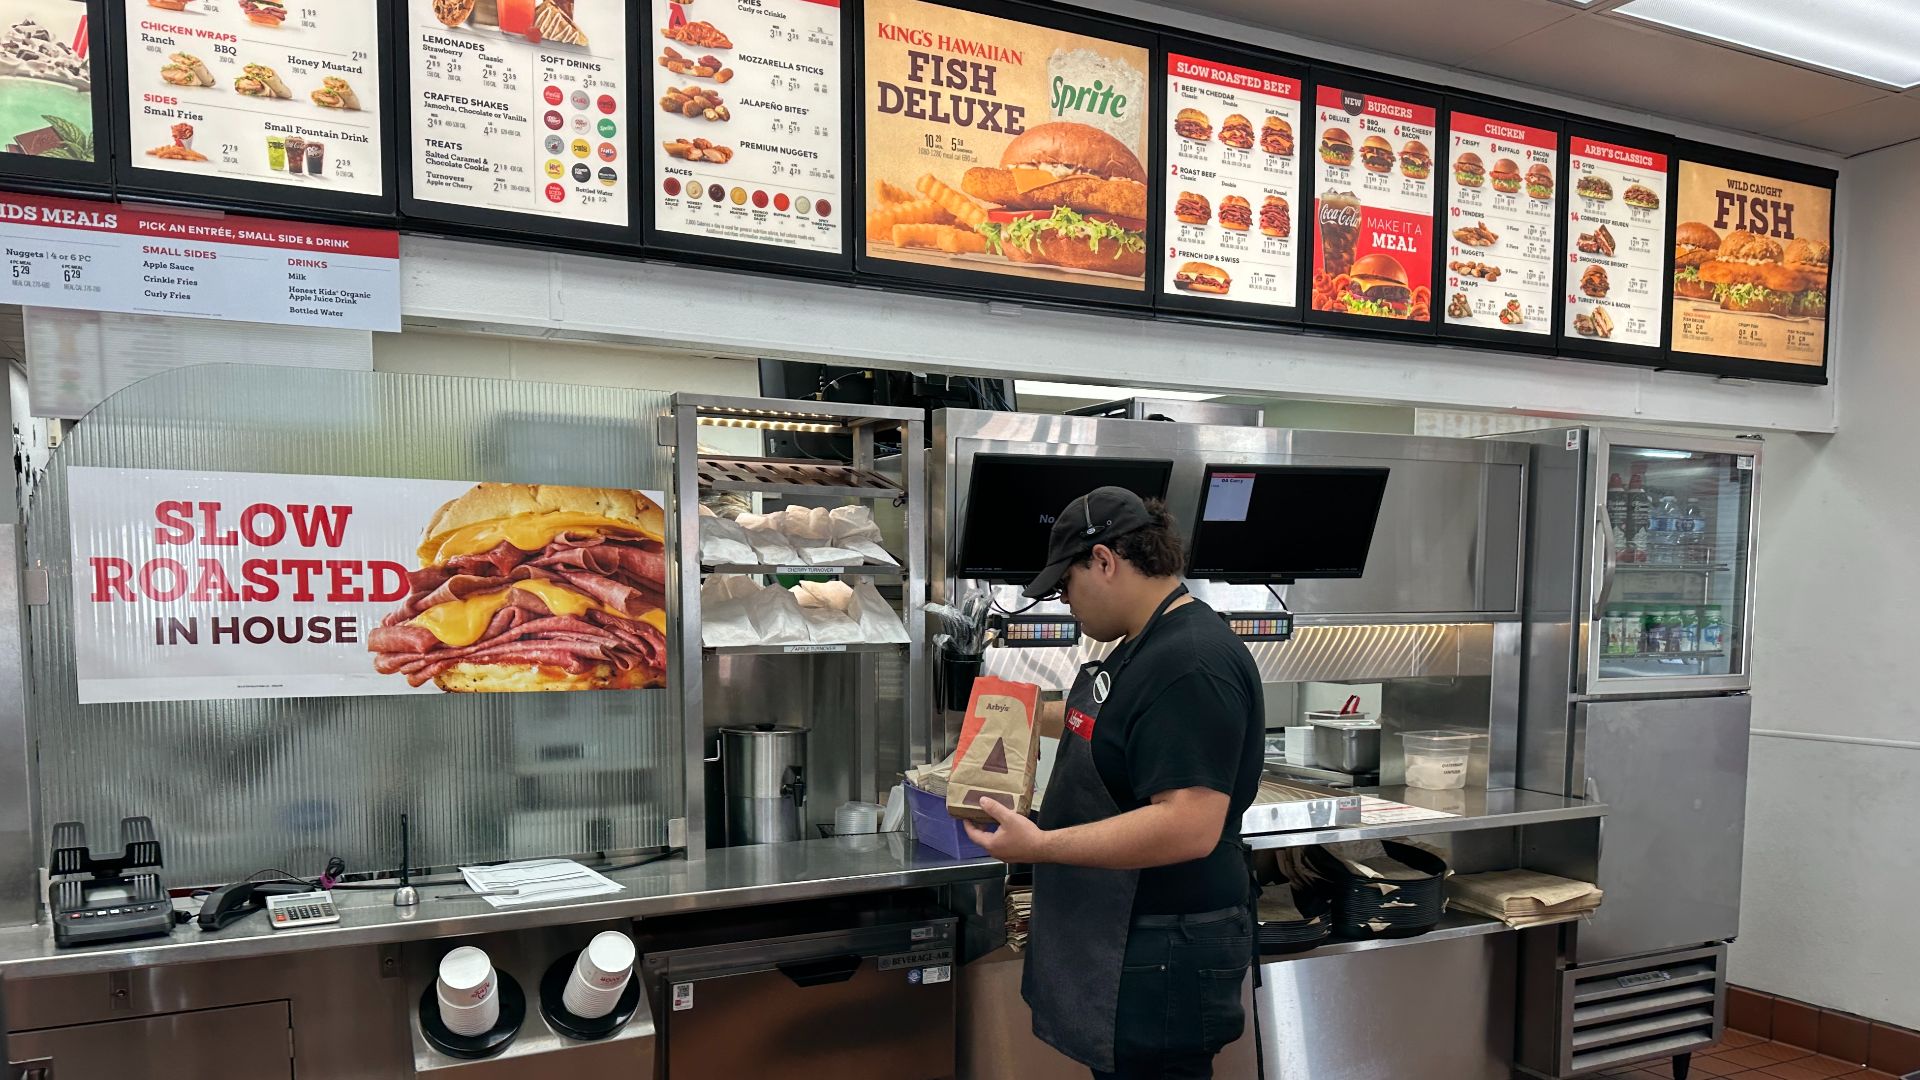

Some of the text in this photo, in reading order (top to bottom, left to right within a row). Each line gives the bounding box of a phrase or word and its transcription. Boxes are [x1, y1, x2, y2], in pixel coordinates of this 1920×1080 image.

[738, 5, 755, 14] Curly
[764, 10, 786, 19] Crinkle
[141, 21, 237, 43] CHICKEN WRAPS
[142, 33, 175, 46] Ranch
[422, 34, 485, 51] LEMONADES
[878, 23, 1023, 65] KING'S HAWAIIAN
[214, 44, 236, 56] BBQ
[423, 44, 463, 57] Strawberry
[288, 56, 362, 74] Honey Mustard
[479, 54, 503, 63] Classic
[541, 55, 601, 71] SOFT DRINKS
[739, 54, 824, 75] MOZZARELLA STICKS
[908, 50, 997, 96] FISH
[1177, 62, 1291, 95] SLOW ROASTED BEEF
[1051, 75, 1127, 117] Sprite
[1173, 82, 1178, 92] 1
[1182, 85, 1197, 93] BEEF
[1205, 90, 1235, 100] CHEDDAR
[144, 93, 177, 105] SIDES
[424, 91, 509, 110] CRAFTED SHAKES
[740, 98, 783, 111] JALAPEÑO
[144, 106, 203, 121] Small Fries
[424, 101, 457, 112] Jamocha,
[459, 106, 492, 117] Chocolate
[503, 113, 526, 122] Vanilla
[878, 81, 1025, 136] DELUXE
[1344, 96, 1413, 119] NEW BURGERS
[1329, 114, 1350, 124] DELUXE
[265, 122, 368, 143] Small Fountain Drink
[1367, 125, 1386, 134] BACON
[1402, 132, 1420, 140] BACON
[1411, 127, 1432, 136] CHEESY
[1485, 124, 1525, 140] CHICKEN
[425, 139, 462, 150] TREATS
[1462, 139, 1480, 147] CRISPY
[740, 141, 818, 159] PREMIUM NUGGETS
[1498, 146, 1520, 155] BUFFALO
[1533, 150, 1549, 158] BACON
[1585, 145, 1652, 166] ARBY'S CLASSICS
[426, 151, 449, 160] Salted
[451, 154, 481, 163] Caramel
[425, 158, 489, 172] Chocolate Cookie
[665, 167, 692, 176] SAUCES
[1171, 165, 1216, 178] 2 ROAST BEEF
[426, 171, 464, 182] Turnovers
[452, 181, 472, 190] Cherry
[576, 186, 595, 194] Bottled
[1727, 179, 1783, 198] WILD CAUGHT
[42, 208, 117, 228] MEALS
[1451, 207, 1484, 218] 10 TENDERS
[1571, 212, 1579, 221] 14
[1714, 190, 1795, 240] FISH
[1367, 217, 1423, 235] MAKE IT A
[139, 221, 350, 248] PICK AN ENTRÉE, SMALL SIDE & DRINK
[1372, 232, 1417, 252] MEAL
[6, 248, 43, 258] Nuggets
[143, 245, 217, 259] SMALL SIDES
[1169, 247, 1176, 258] 3
[1179, 251, 1203, 259] FRENCH
[1221, 256, 1240, 264] SWISS
[1451, 246, 1485, 257] 11 NUGGETS
[143, 260, 194, 271] Apple Sauce
[288, 258, 328, 269] DRINKS
[1570, 254, 1628, 268] 15 SMOKEHOUSE BRISKET
[13, 266, 30, 278] 529
[64, 270, 81, 282] 629
[144, 275, 198, 286] Crinkle Fries
[1449, 277, 1459, 287] 12
[144, 290, 191, 300] Curly Fries
[289, 286, 317, 295] Honest
[340, 290, 371, 300] Organic
[289, 293, 312, 302] Apple
[335, 296, 357, 304] Drink
[1568, 295, 1576, 304] 16
[290, 307, 343, 317] Bottled Water
[154, 500, 352, 549] SLOW
[1040, 514, 1055, 523] No
[90, 556, 409, 603] ROASTED
[156, 615, 357, 646] IN HOUSE
[986, 703, 1009, 712] Arby's
[892, 952, 949, 965] BEVERAGE-AIR
